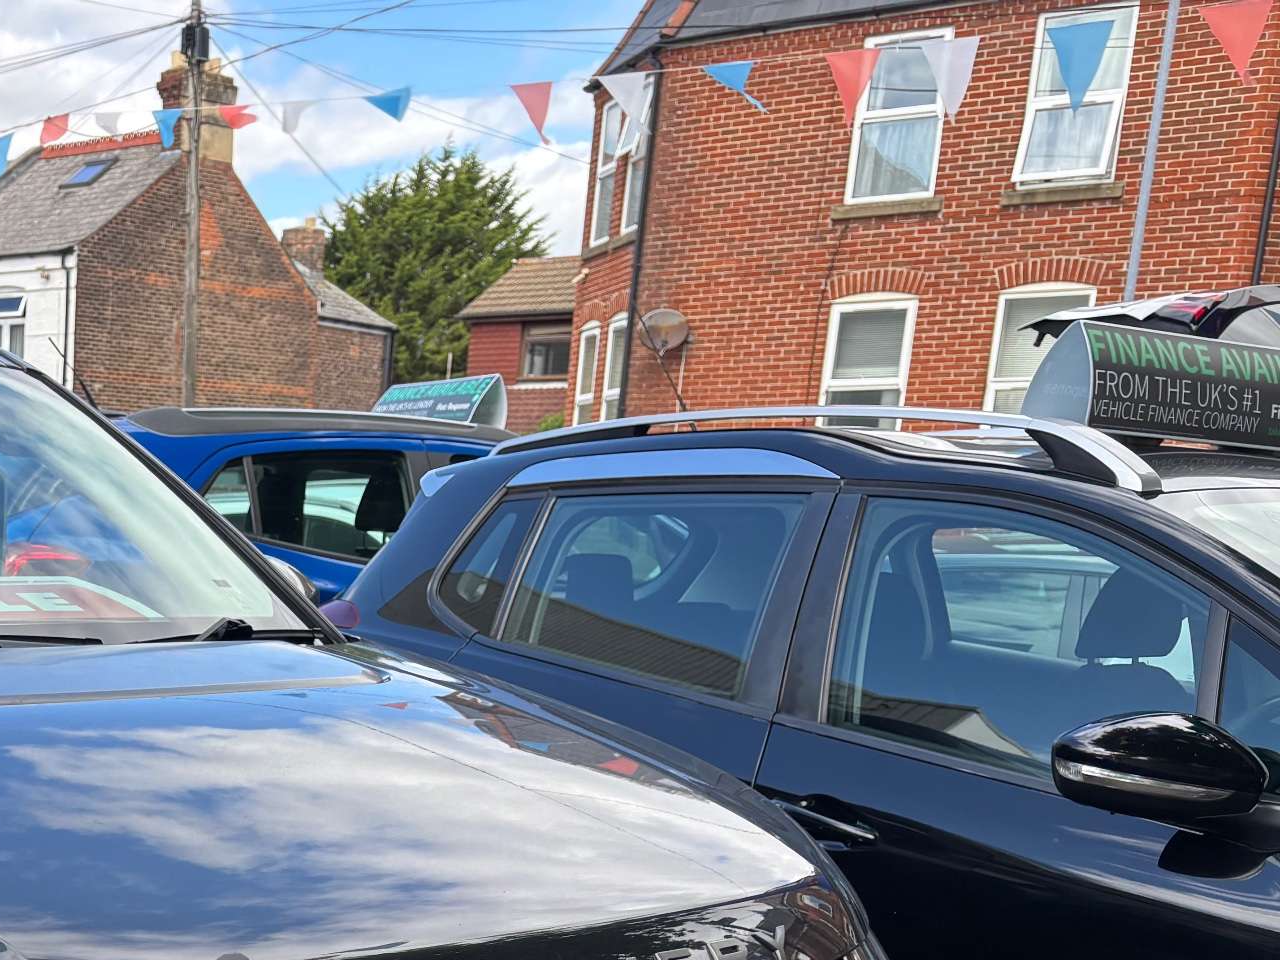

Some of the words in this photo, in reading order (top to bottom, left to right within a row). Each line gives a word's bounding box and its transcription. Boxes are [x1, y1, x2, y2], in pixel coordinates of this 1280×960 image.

[1087, 329, 1216, 377] FINANCE
[1094, 369, 1150, 401] FROM
[1154, 376, 1192, 406] THE
[1197, 381, 1238, 412] UK'S
[1242, 387, 1262, 414] #1
[1092, 398, 1146, 422] VEHICLE
[1147, 404, 1202, 428] FINANCE
[1202, 410, 1261, 434] COMPANY
